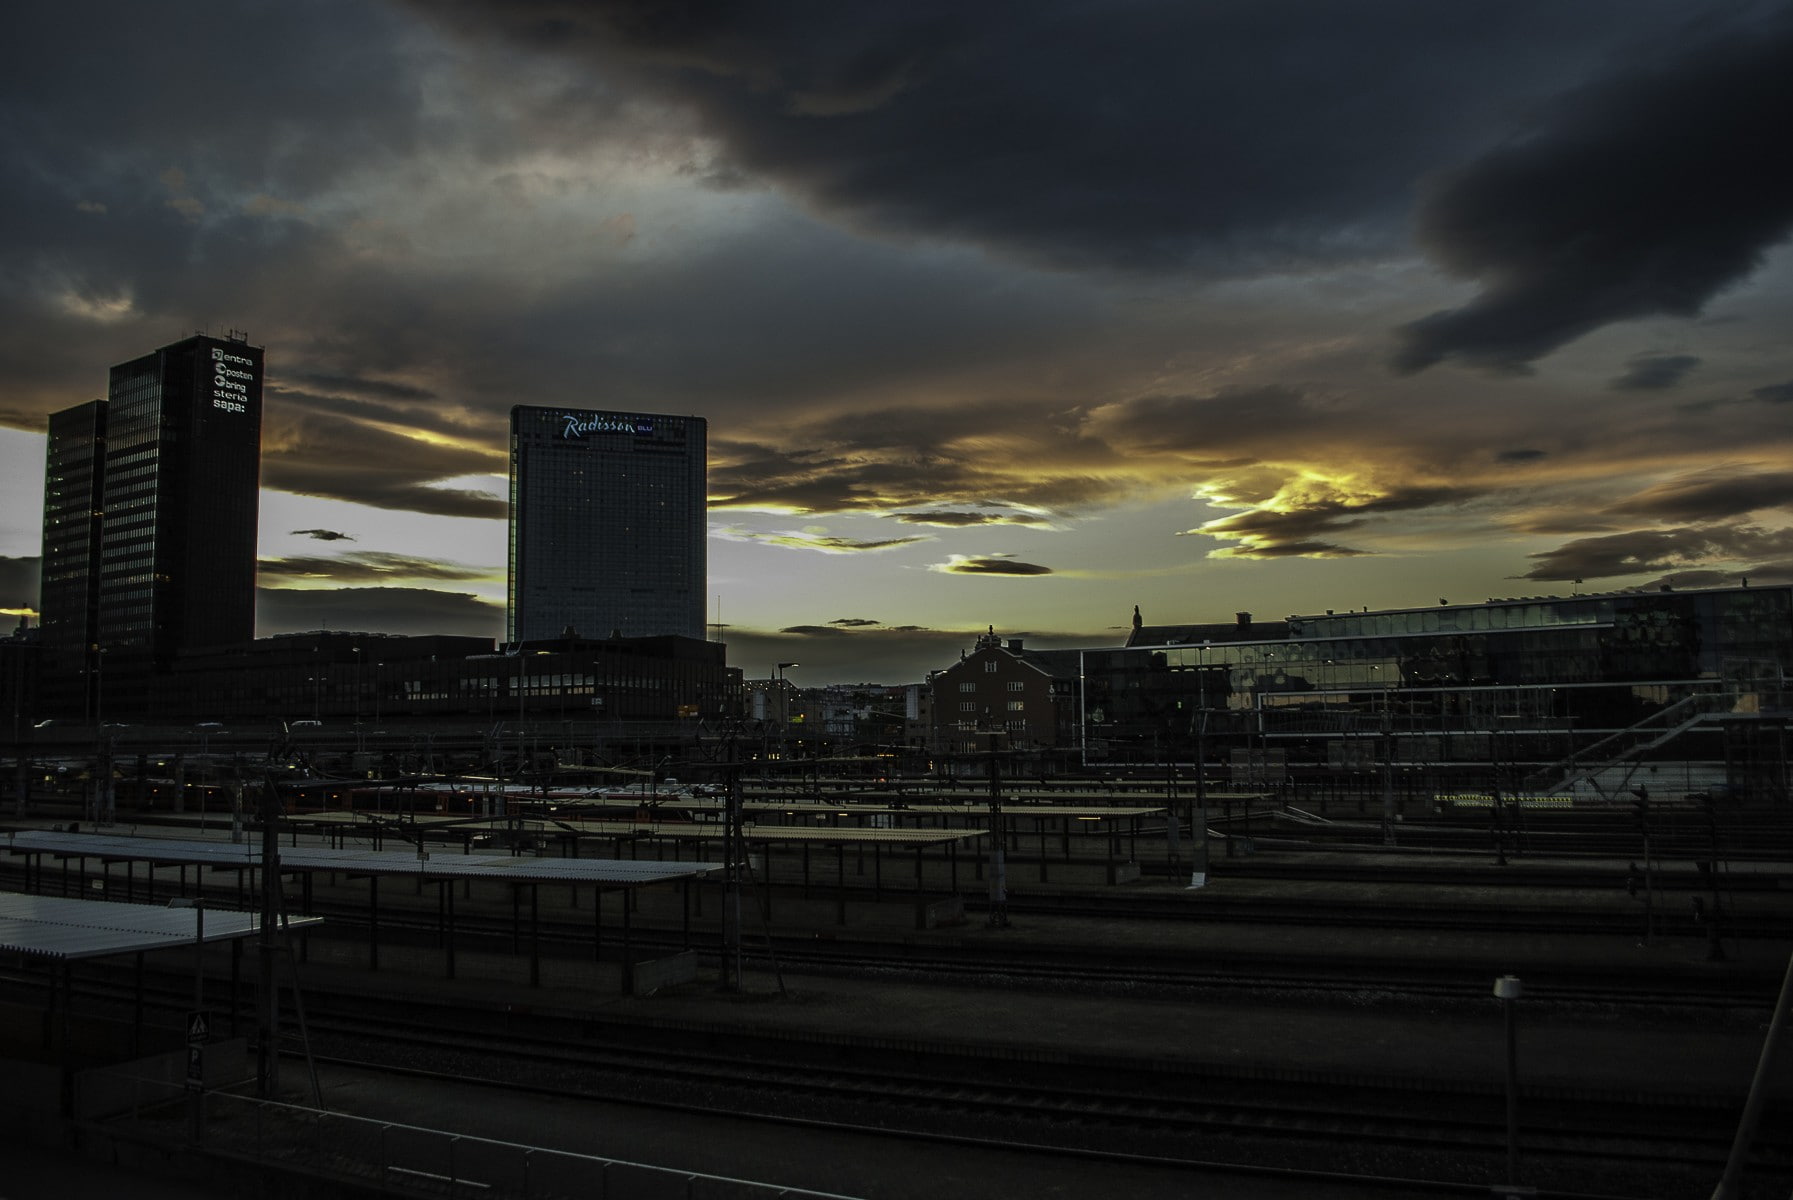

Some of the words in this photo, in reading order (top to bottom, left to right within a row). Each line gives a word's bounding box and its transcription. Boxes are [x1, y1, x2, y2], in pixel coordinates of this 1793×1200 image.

[223, 354, 253, 366] entra
[226, 369, 253, 381] posten
[225, 380, 246, 394] bring
[213, 389, 248, 402] steria
[213, 399, 245, 413] sapa:
[562, 413, 636, 439] Radisson
